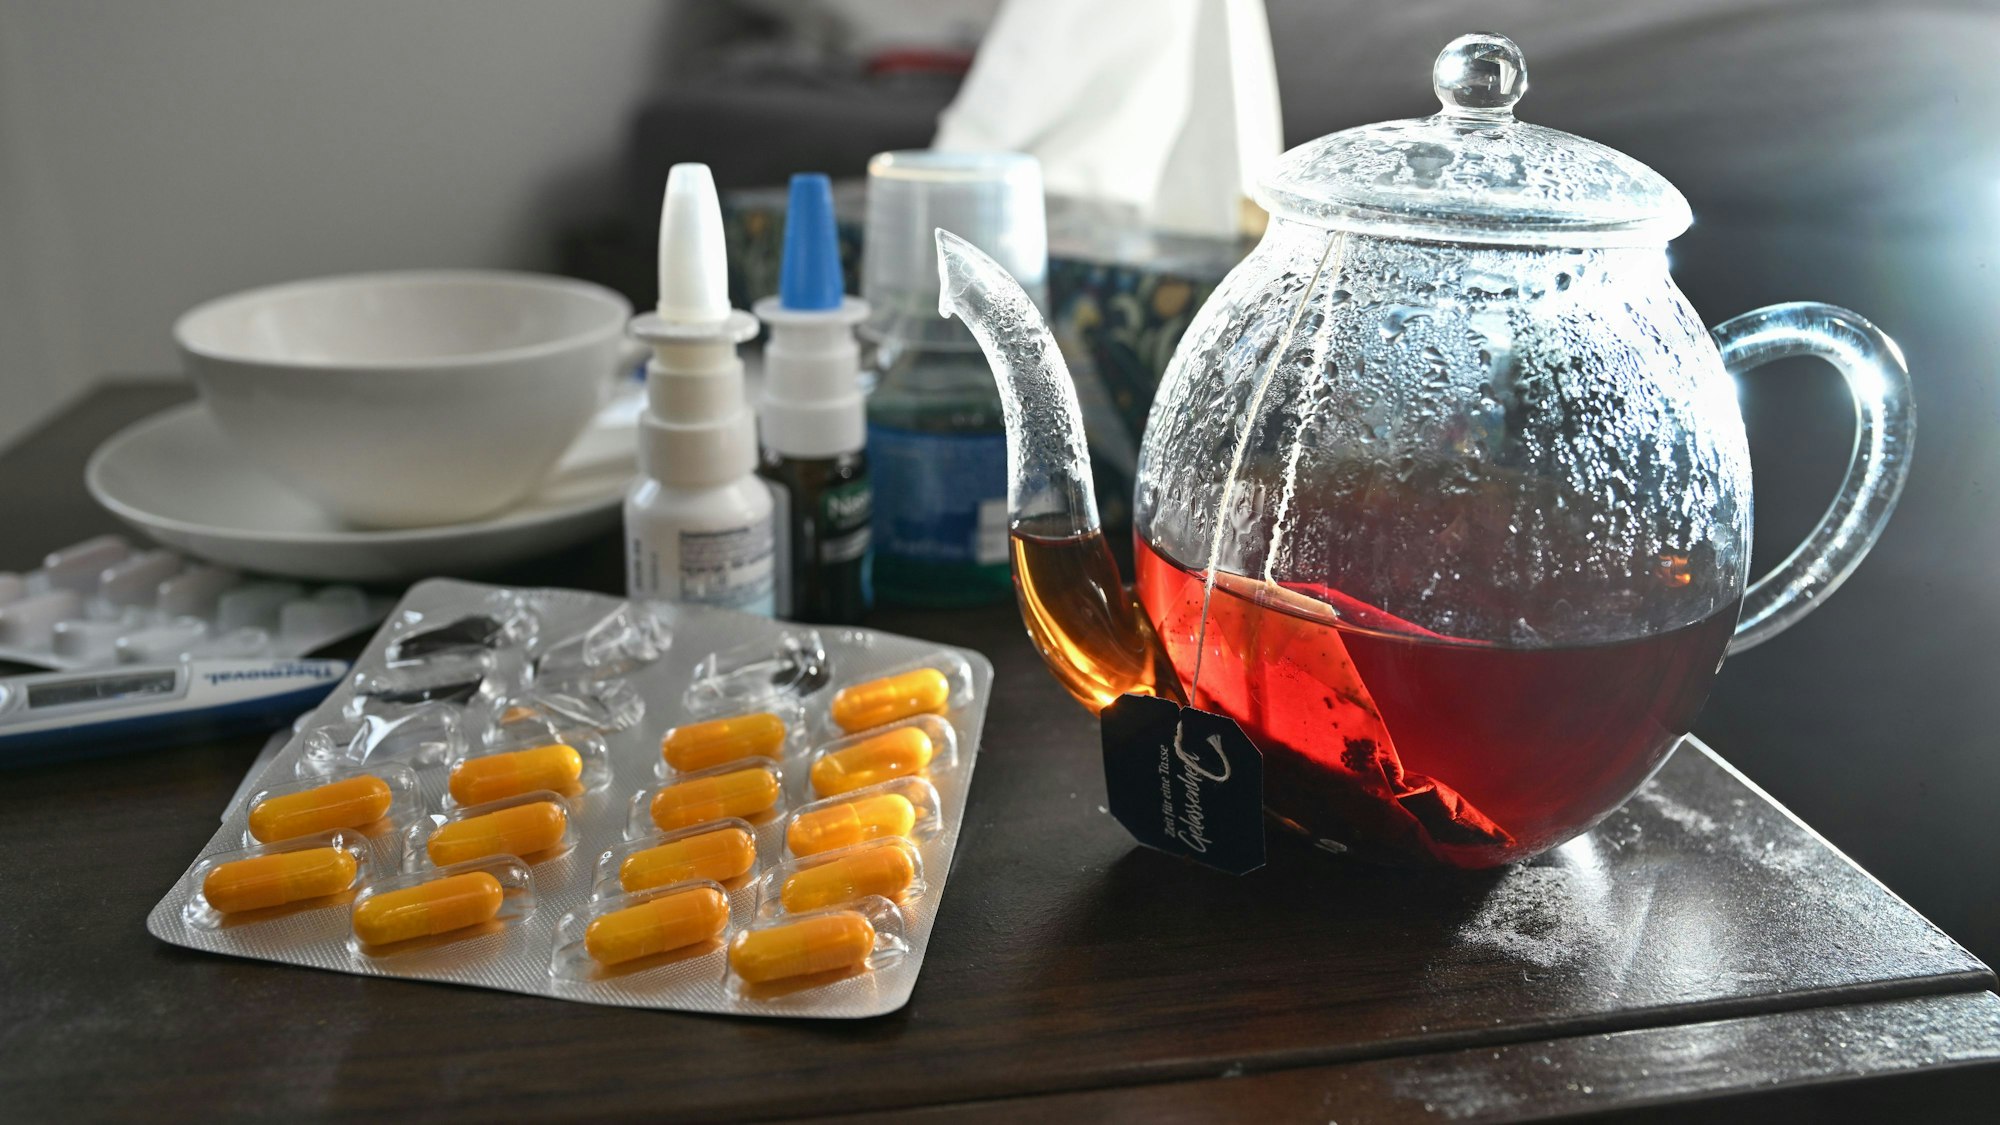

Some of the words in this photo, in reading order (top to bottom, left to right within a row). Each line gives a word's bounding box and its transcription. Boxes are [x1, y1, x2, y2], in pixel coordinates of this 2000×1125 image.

[1158, 744, 1170, 775] Tasse
[1160, 776, 1172, 800] eine
[1162, 800, 1175, 817] für
[1177, 751, 1212, 853] Gelassenhet
[1163, 816, 1176, 838] Zeit
